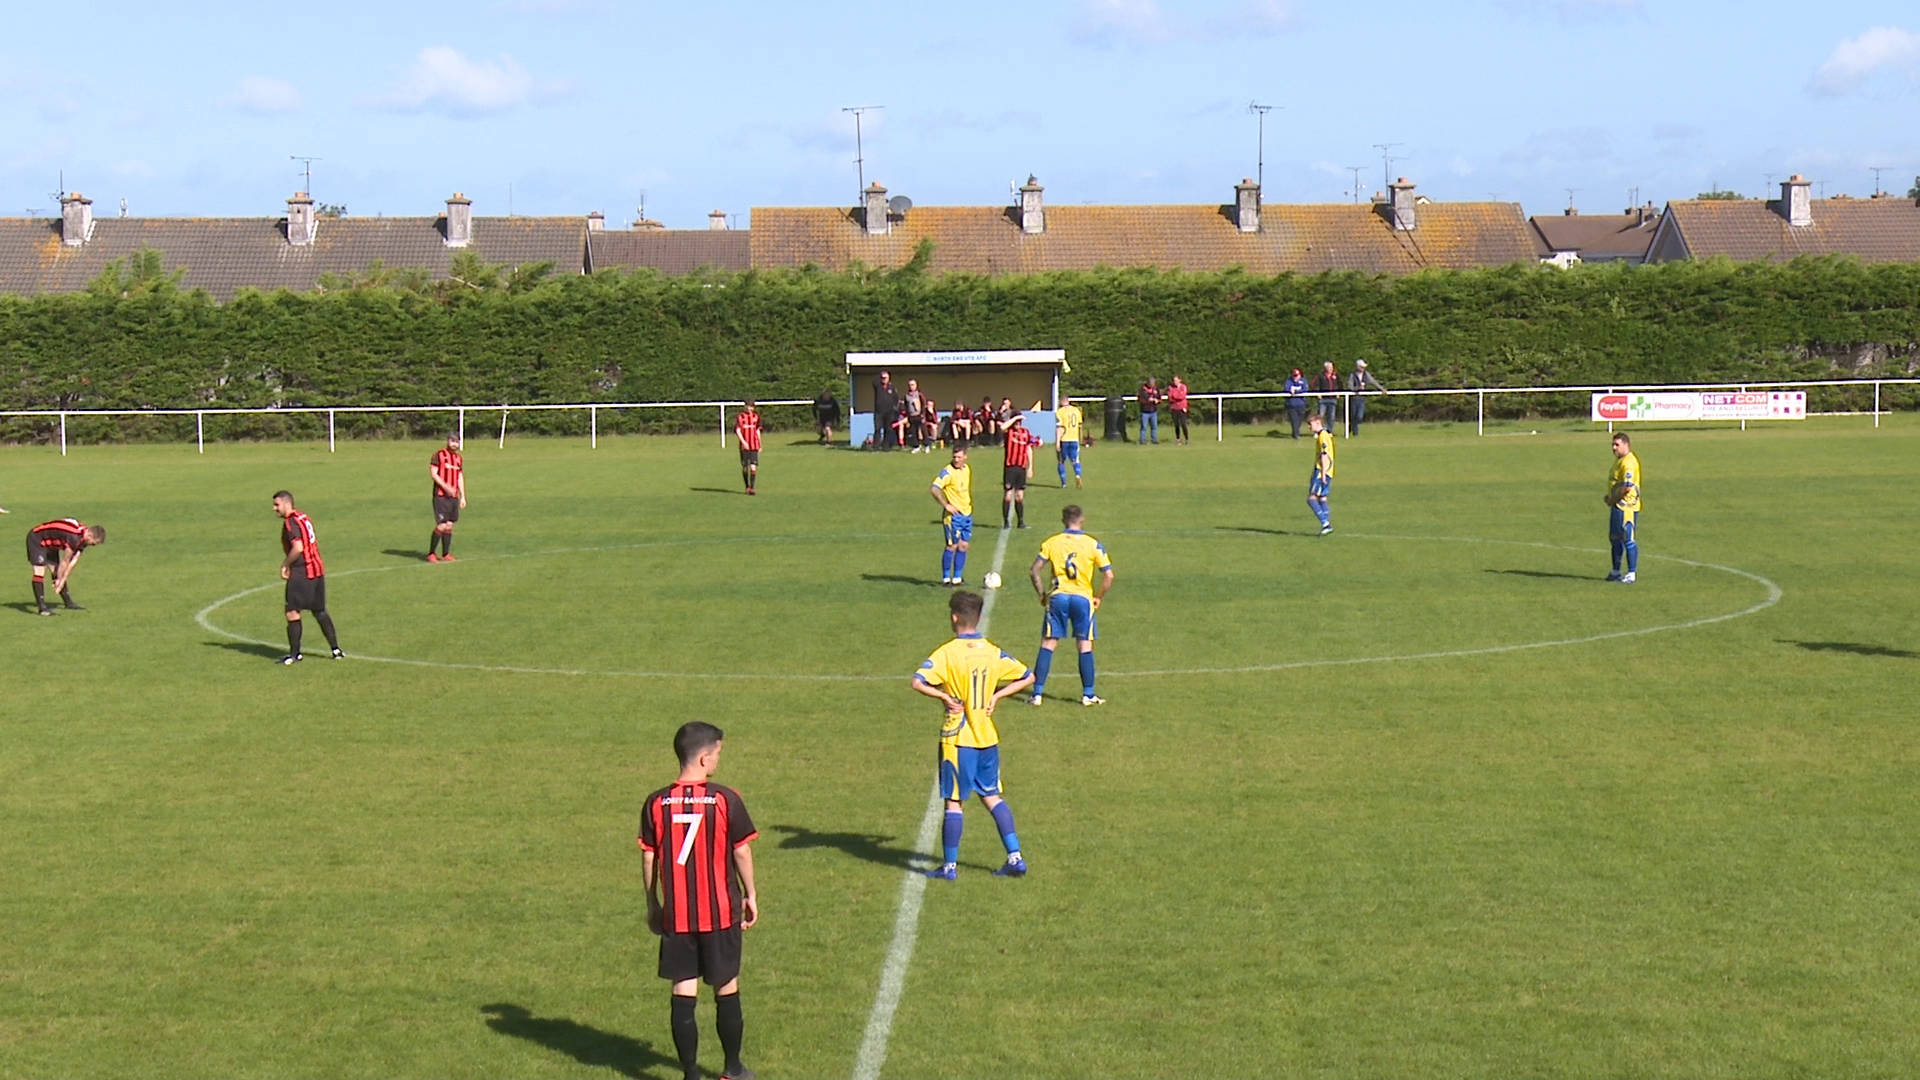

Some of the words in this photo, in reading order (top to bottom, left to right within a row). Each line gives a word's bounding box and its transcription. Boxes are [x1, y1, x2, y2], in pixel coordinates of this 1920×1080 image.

[1600, 402, 1627, 412] Faythe
[1654, 402, 1692, 410] Pharmacy
[1065, 552, 1077, 580] 6
[972, 668, 987, 710] 11
[684, 796, 717, 805] RANGERS
[672, 814, 703, 866] 7
